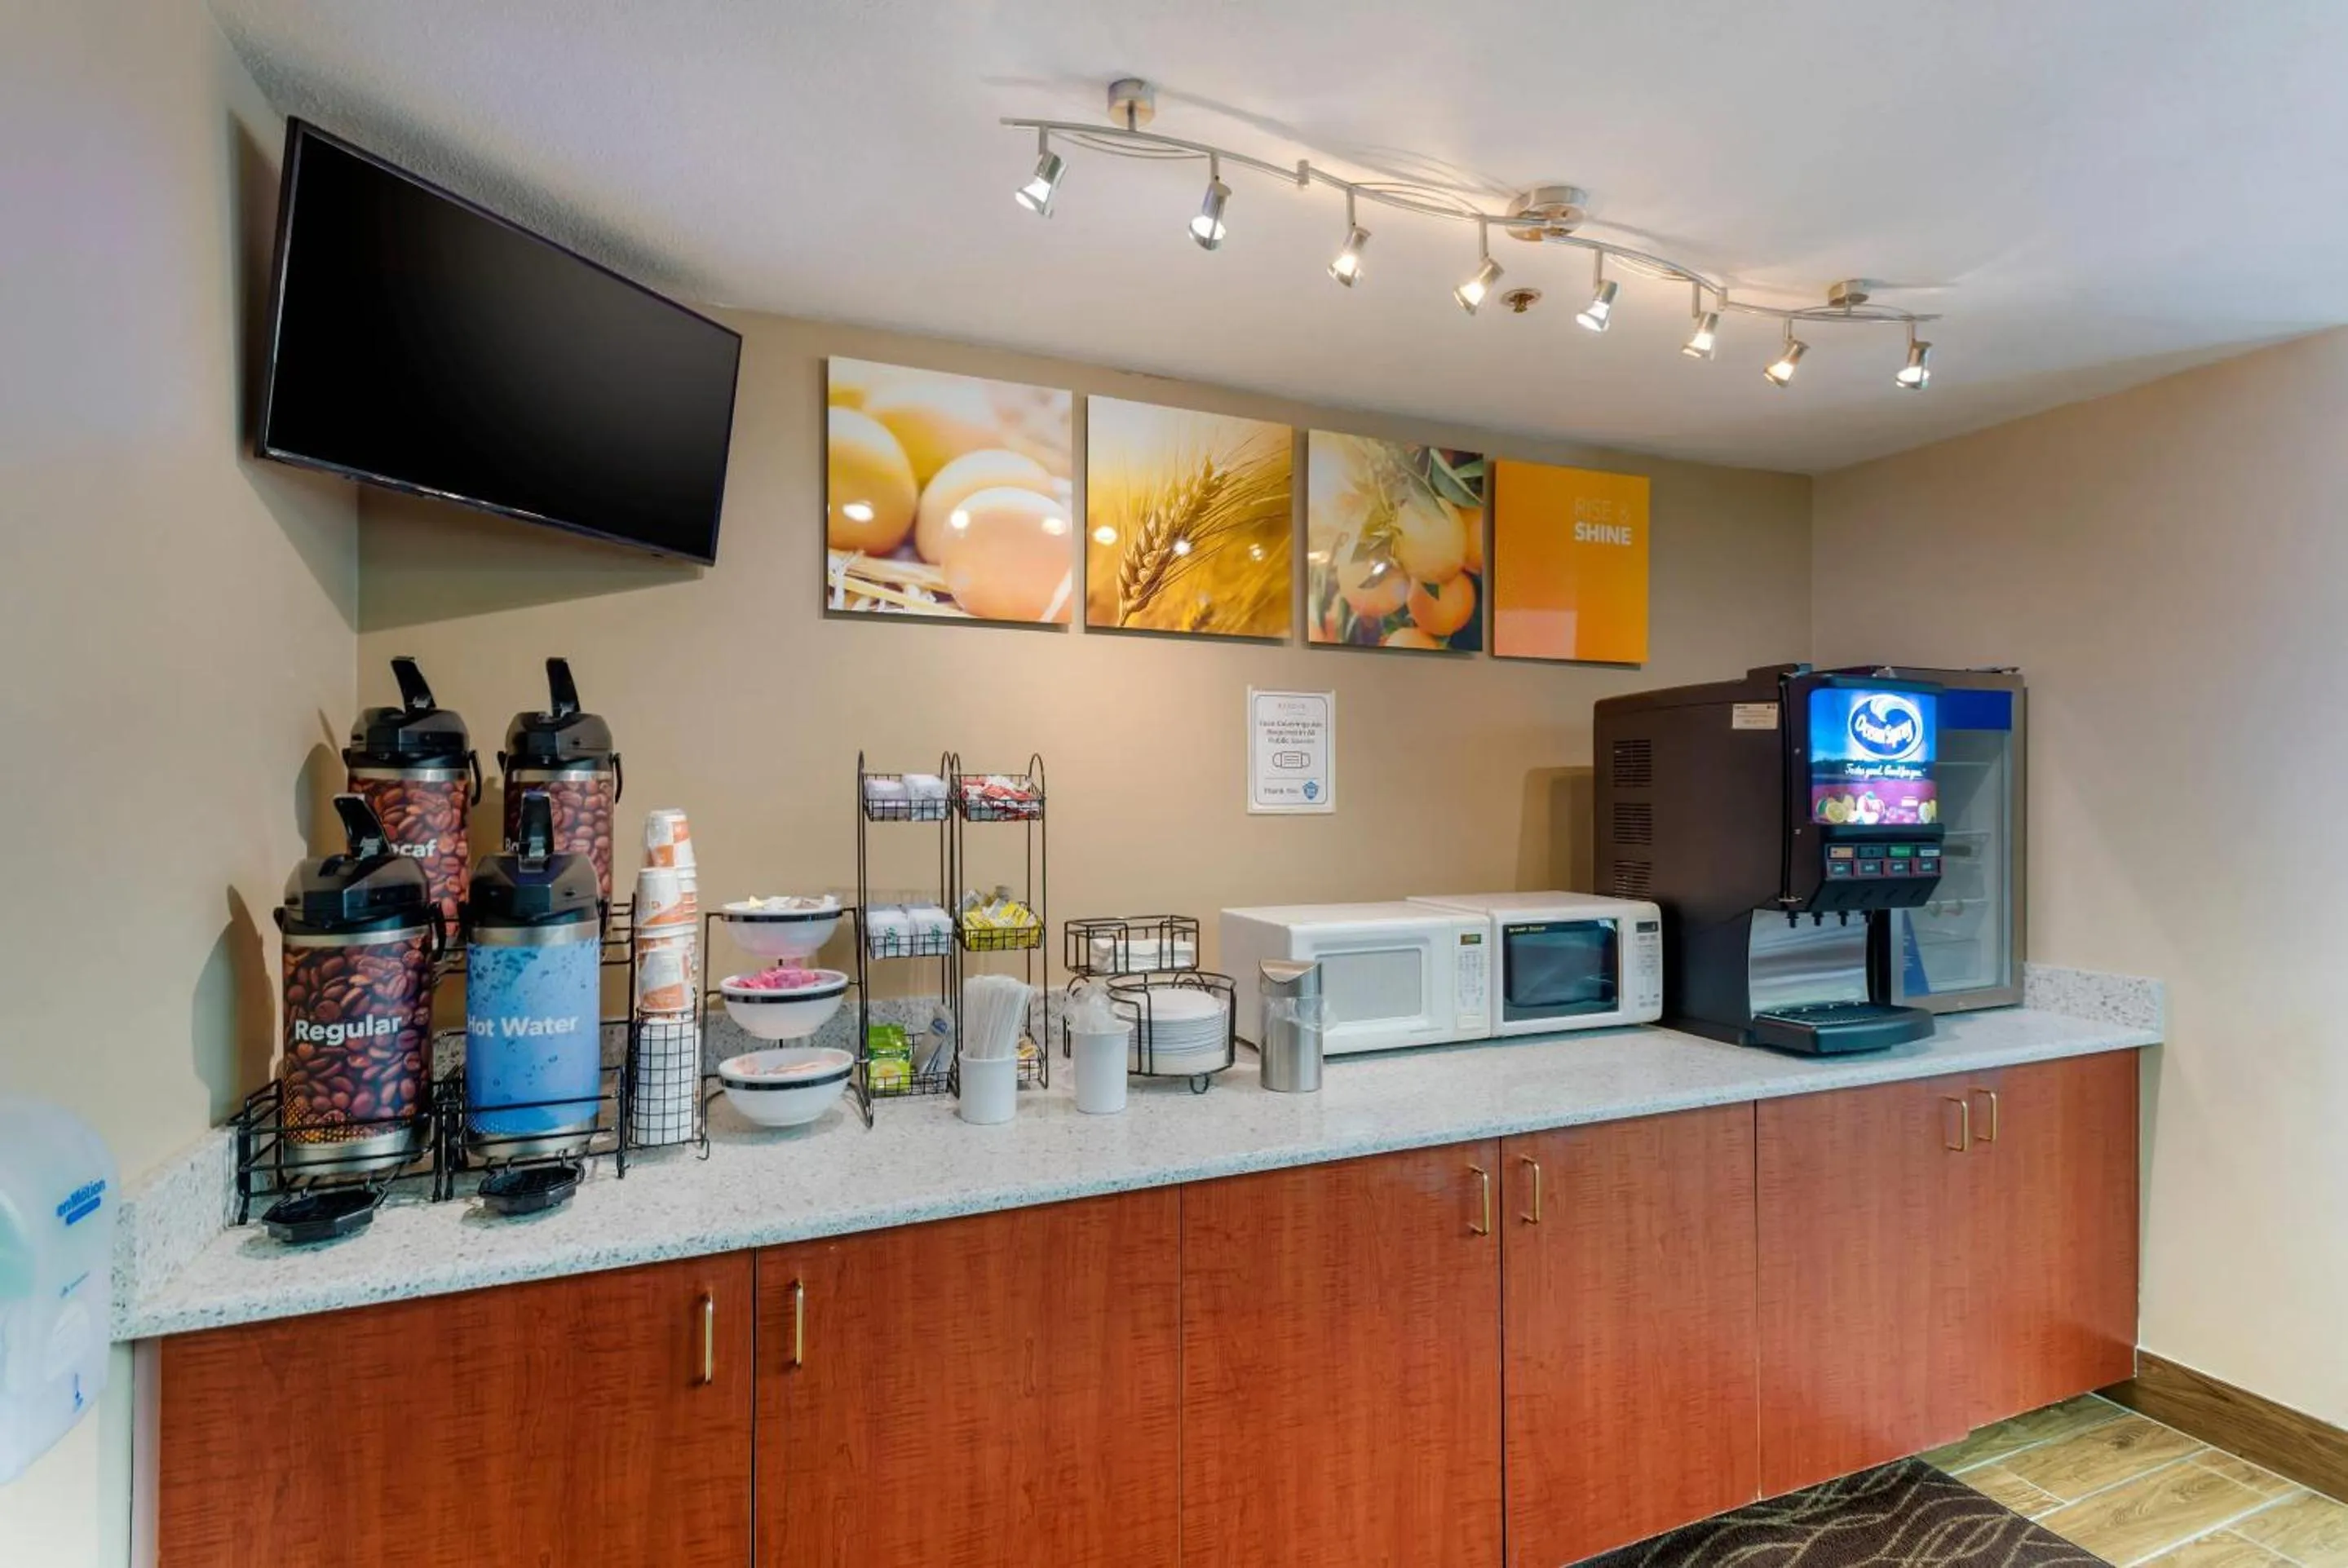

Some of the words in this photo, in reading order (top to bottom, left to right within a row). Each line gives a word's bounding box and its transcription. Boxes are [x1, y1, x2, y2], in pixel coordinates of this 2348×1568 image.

[1574, 521, 1632, 545] SHINE
[391, 838, 438, 857] caf
[294, 1014, 403, 1046] Regular
[467, 1015, 494, 1037] Hot
[501, 1015, 580, 1037] Water
